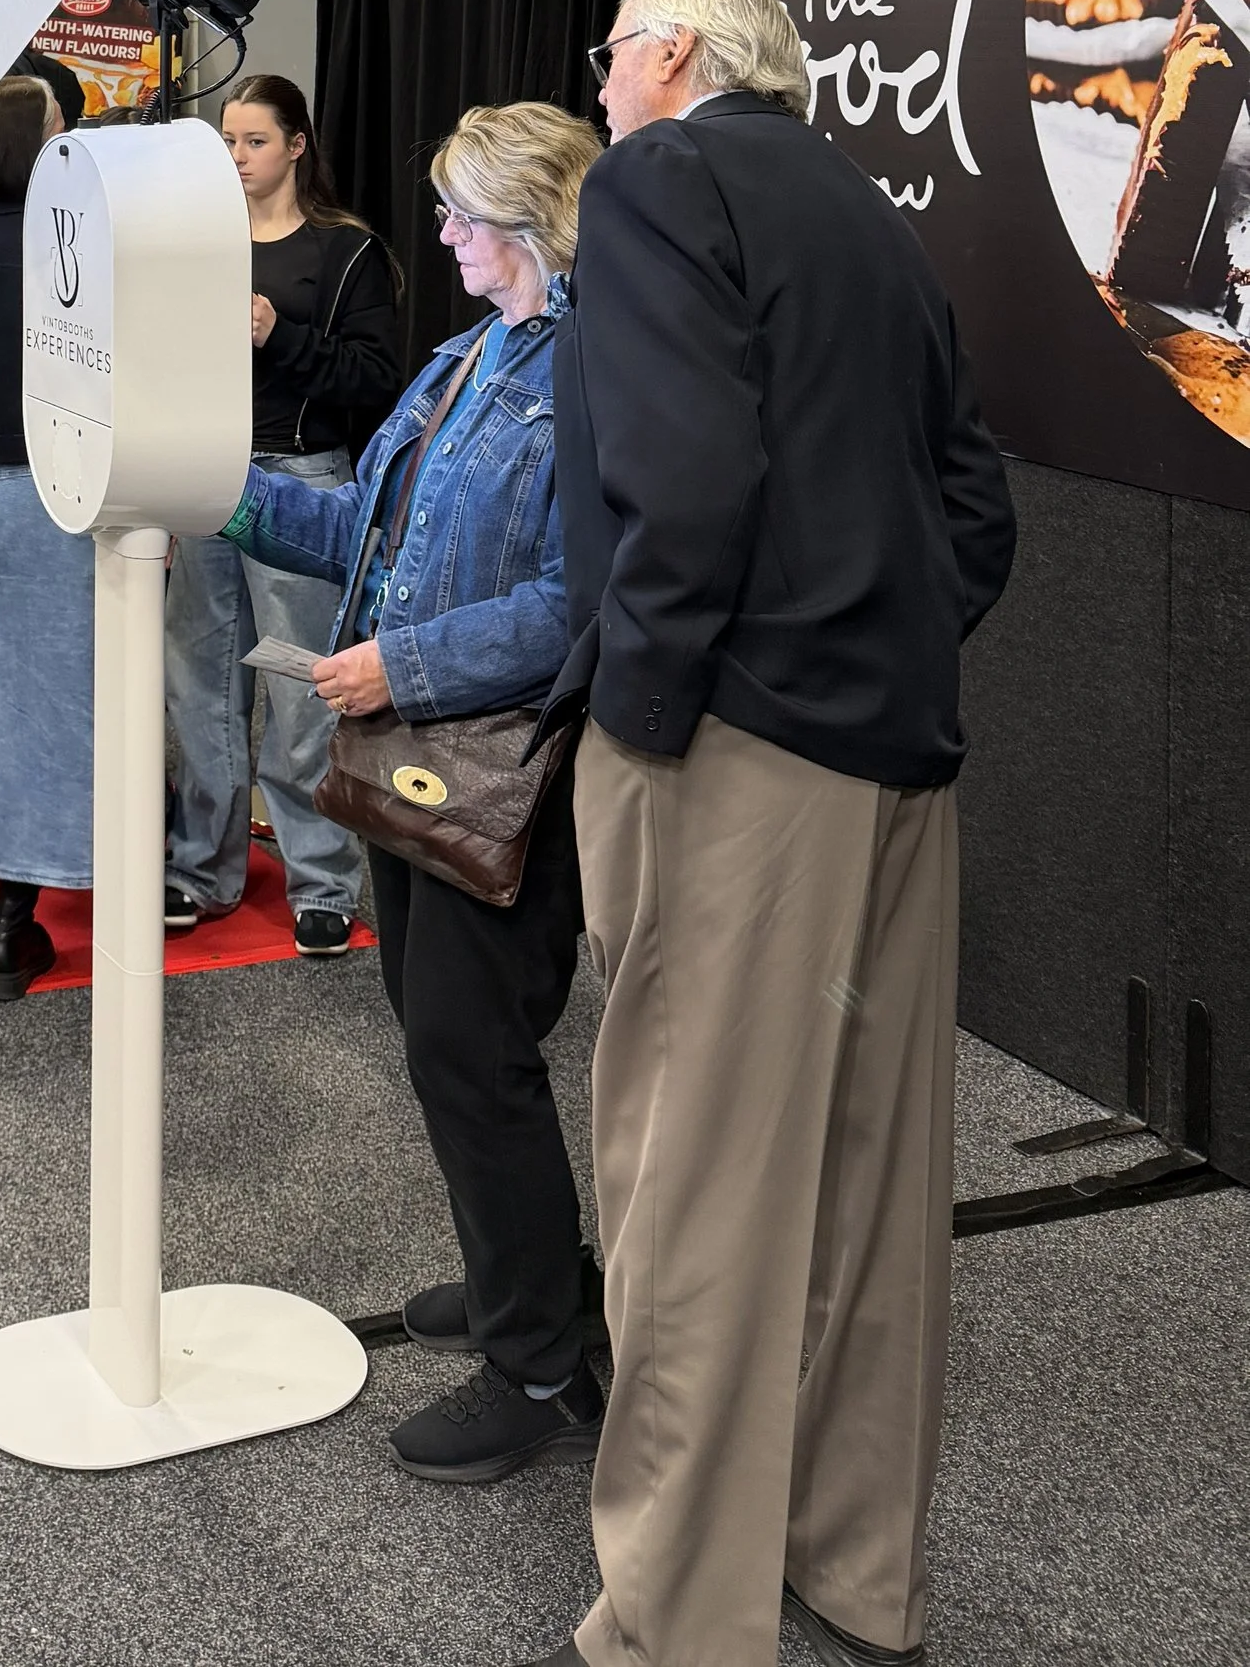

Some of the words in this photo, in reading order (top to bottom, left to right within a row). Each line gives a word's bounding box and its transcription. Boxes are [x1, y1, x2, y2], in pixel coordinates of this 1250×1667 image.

[75, 2, 95, 12] Hill
[40, 19, 153, 43] OUTH-WATERING
[32, 36, 63, 52] NEW
[65, 40, 141, 60] FLAVOURS!
[41, 314, 94, 341] VINTOBOOTHS
[26, 327, 112, 374] EXPERIENCES
